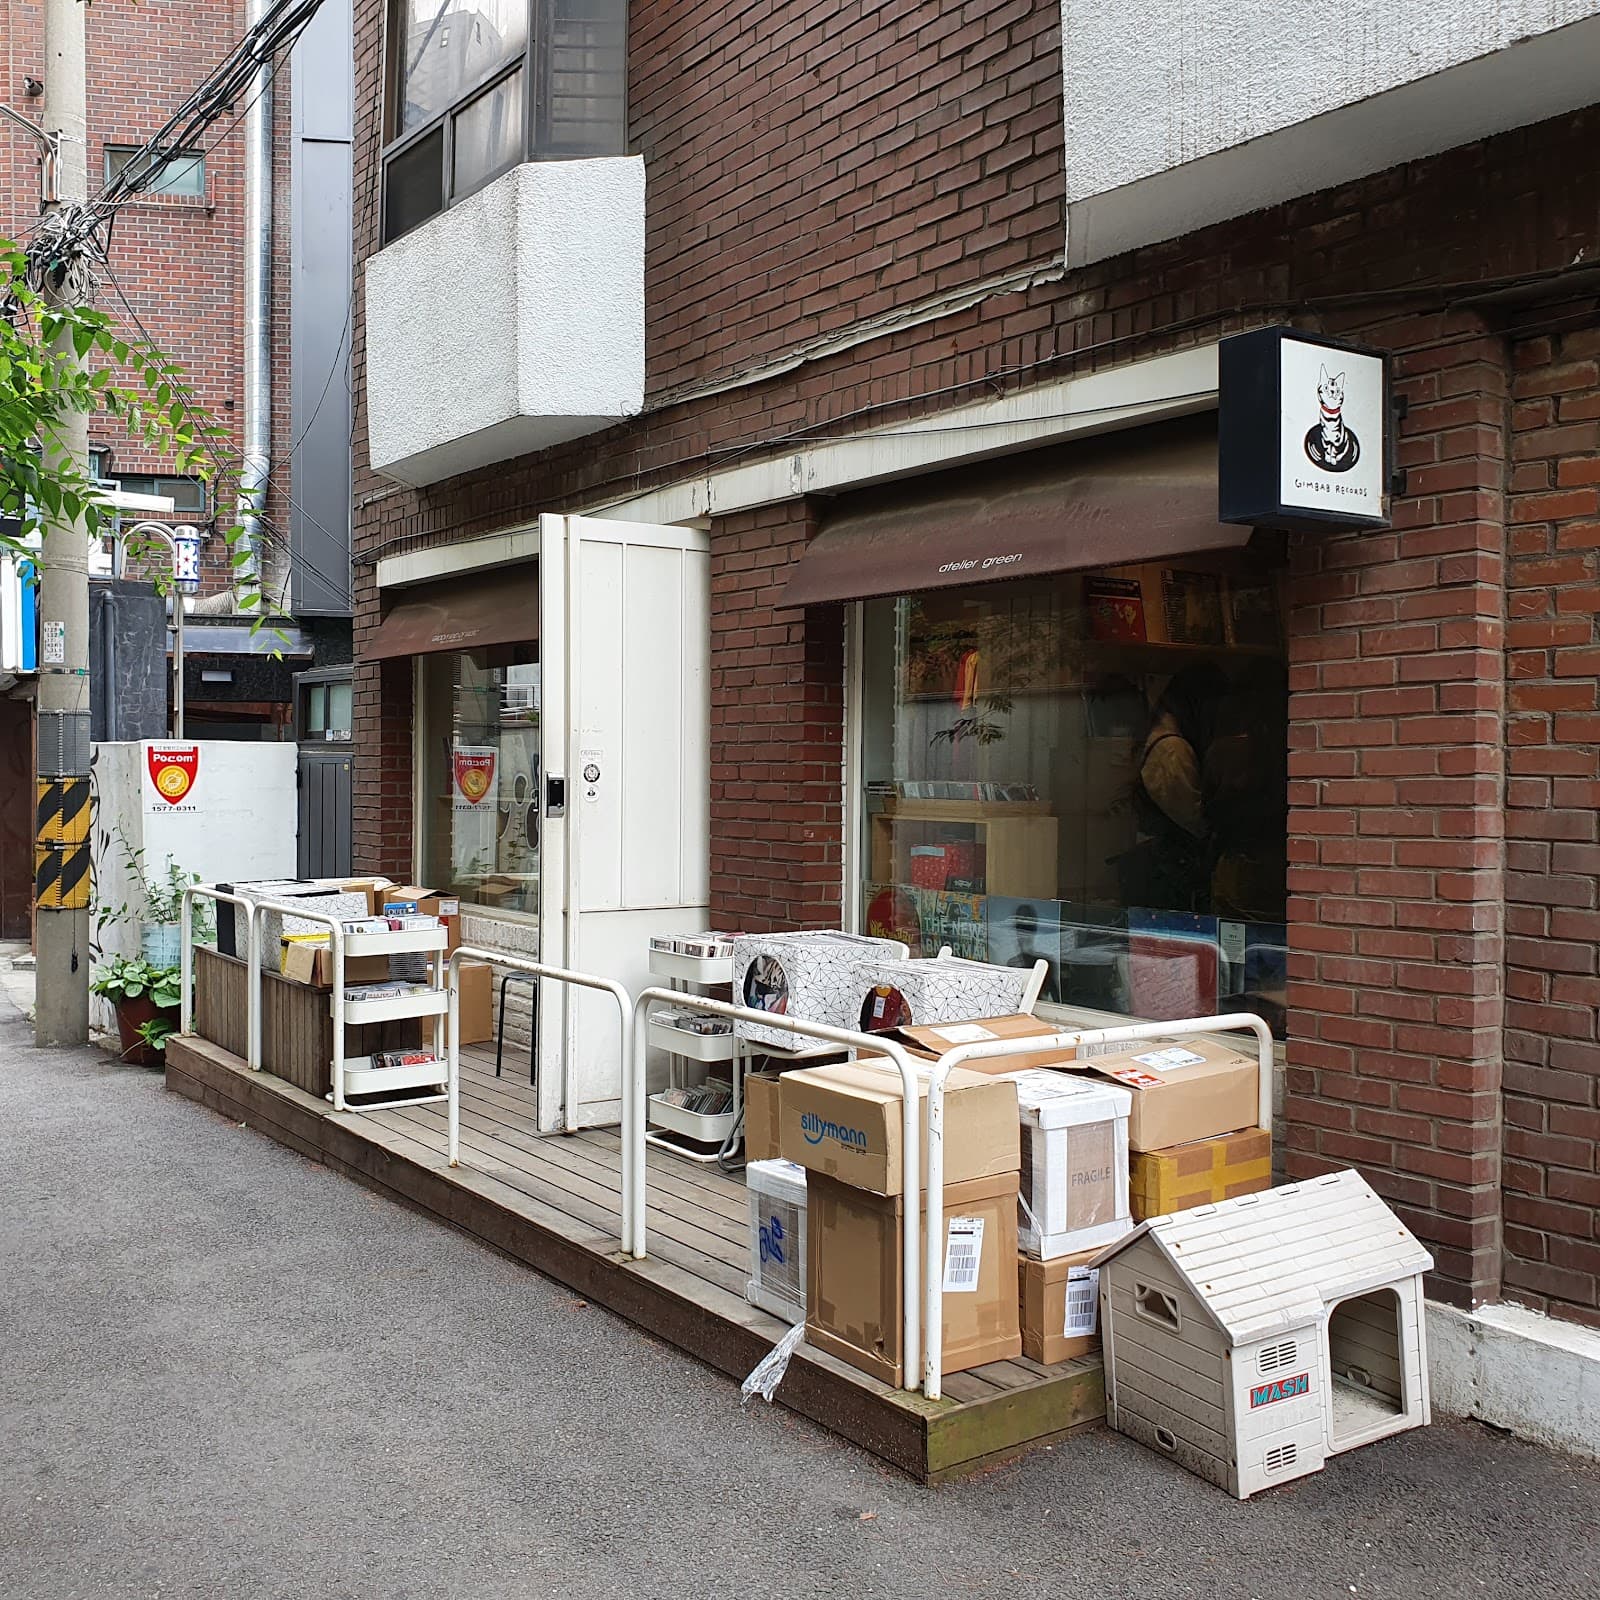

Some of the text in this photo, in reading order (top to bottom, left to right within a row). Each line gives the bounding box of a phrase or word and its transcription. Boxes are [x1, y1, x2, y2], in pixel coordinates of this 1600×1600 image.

[938, 553, 1023, 573] atelier green
[924, 916, 948, 934] THE
[801, 1111, 867, 1148] sillymann
[1071, 1166, 1111, 1187] FRAGILE
[1253, 1375, 1308, 1406] MASH
